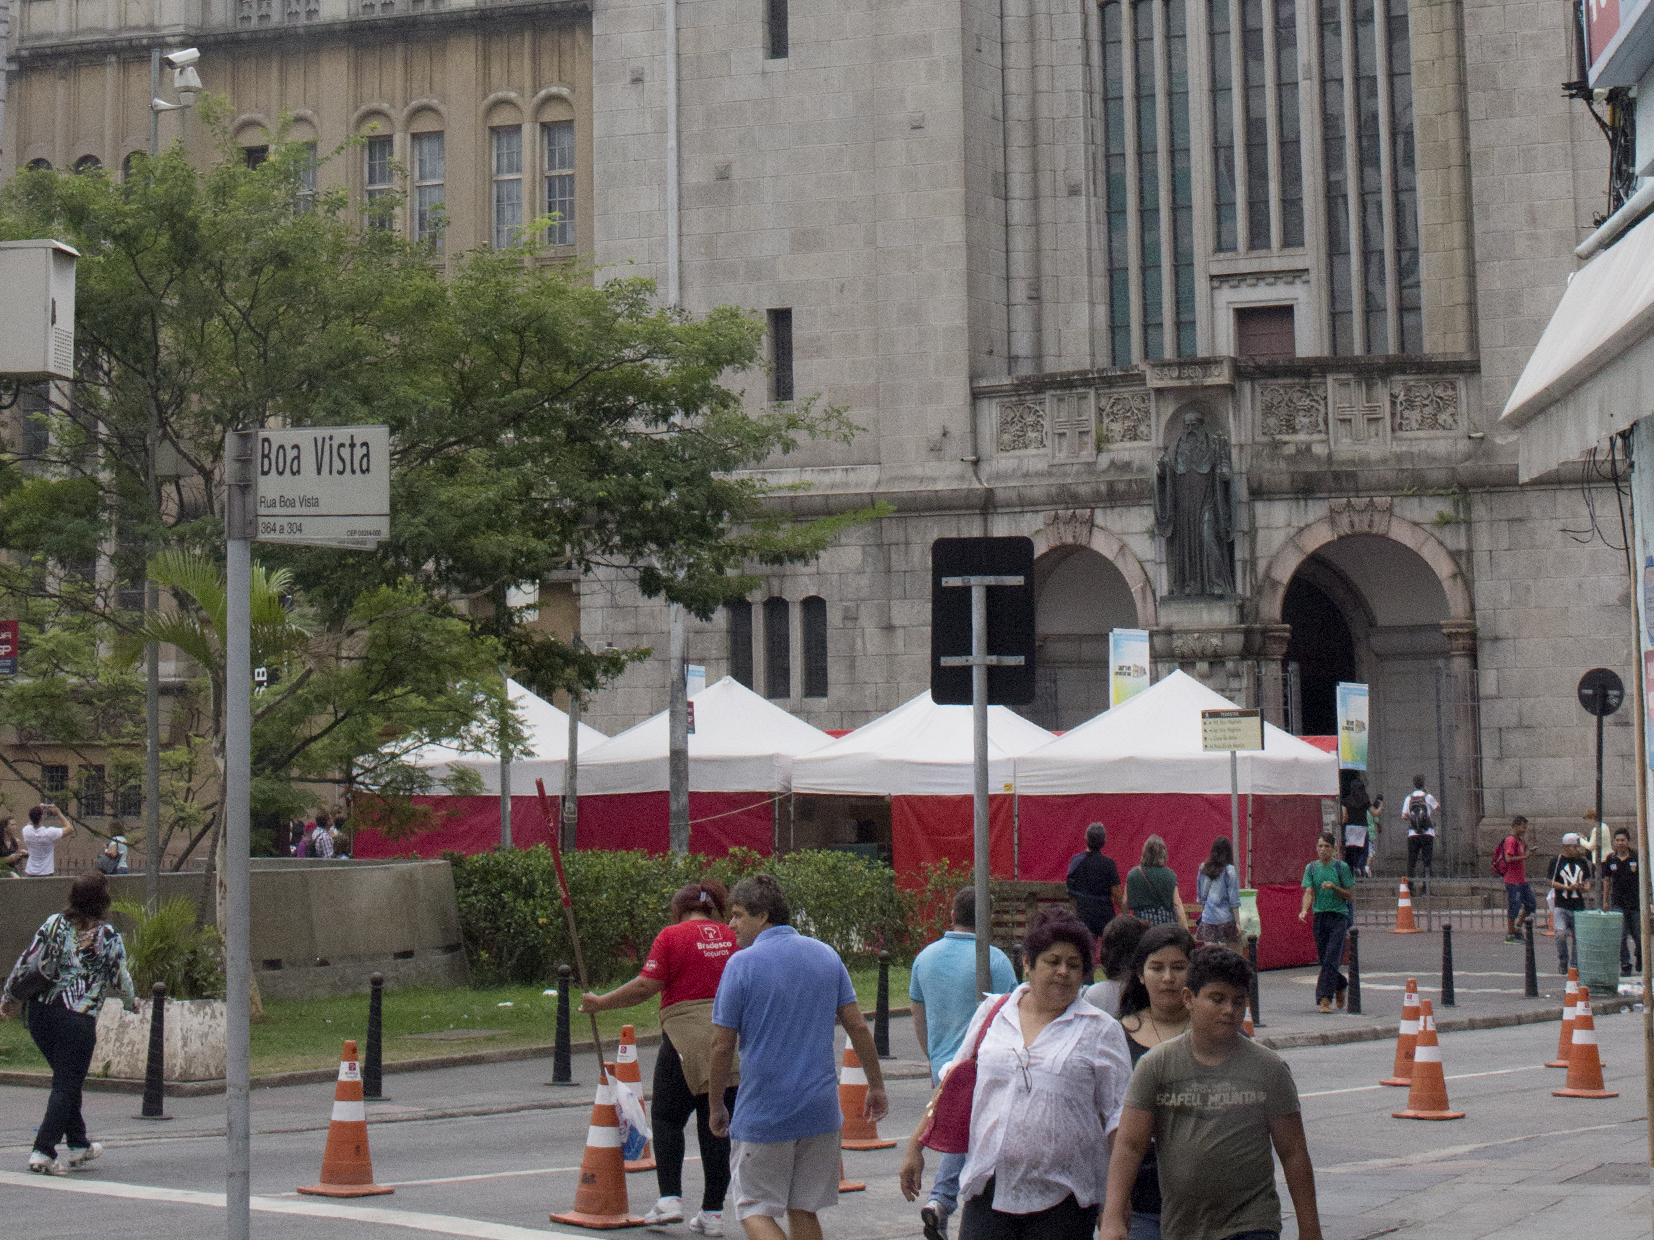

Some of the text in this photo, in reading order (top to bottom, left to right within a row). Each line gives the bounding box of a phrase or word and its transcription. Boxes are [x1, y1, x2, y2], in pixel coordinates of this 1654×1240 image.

[260, 434, 371, 476] Boa Vista
[259, 494, 319, 508] Rua Boa Vista
[260, 522, 303, 534] 364 a 304
[346, 529, 358, 537] CEP
[696, 941, 733, 950] Bradesco
[703, 949, 729, 958] Seguros
